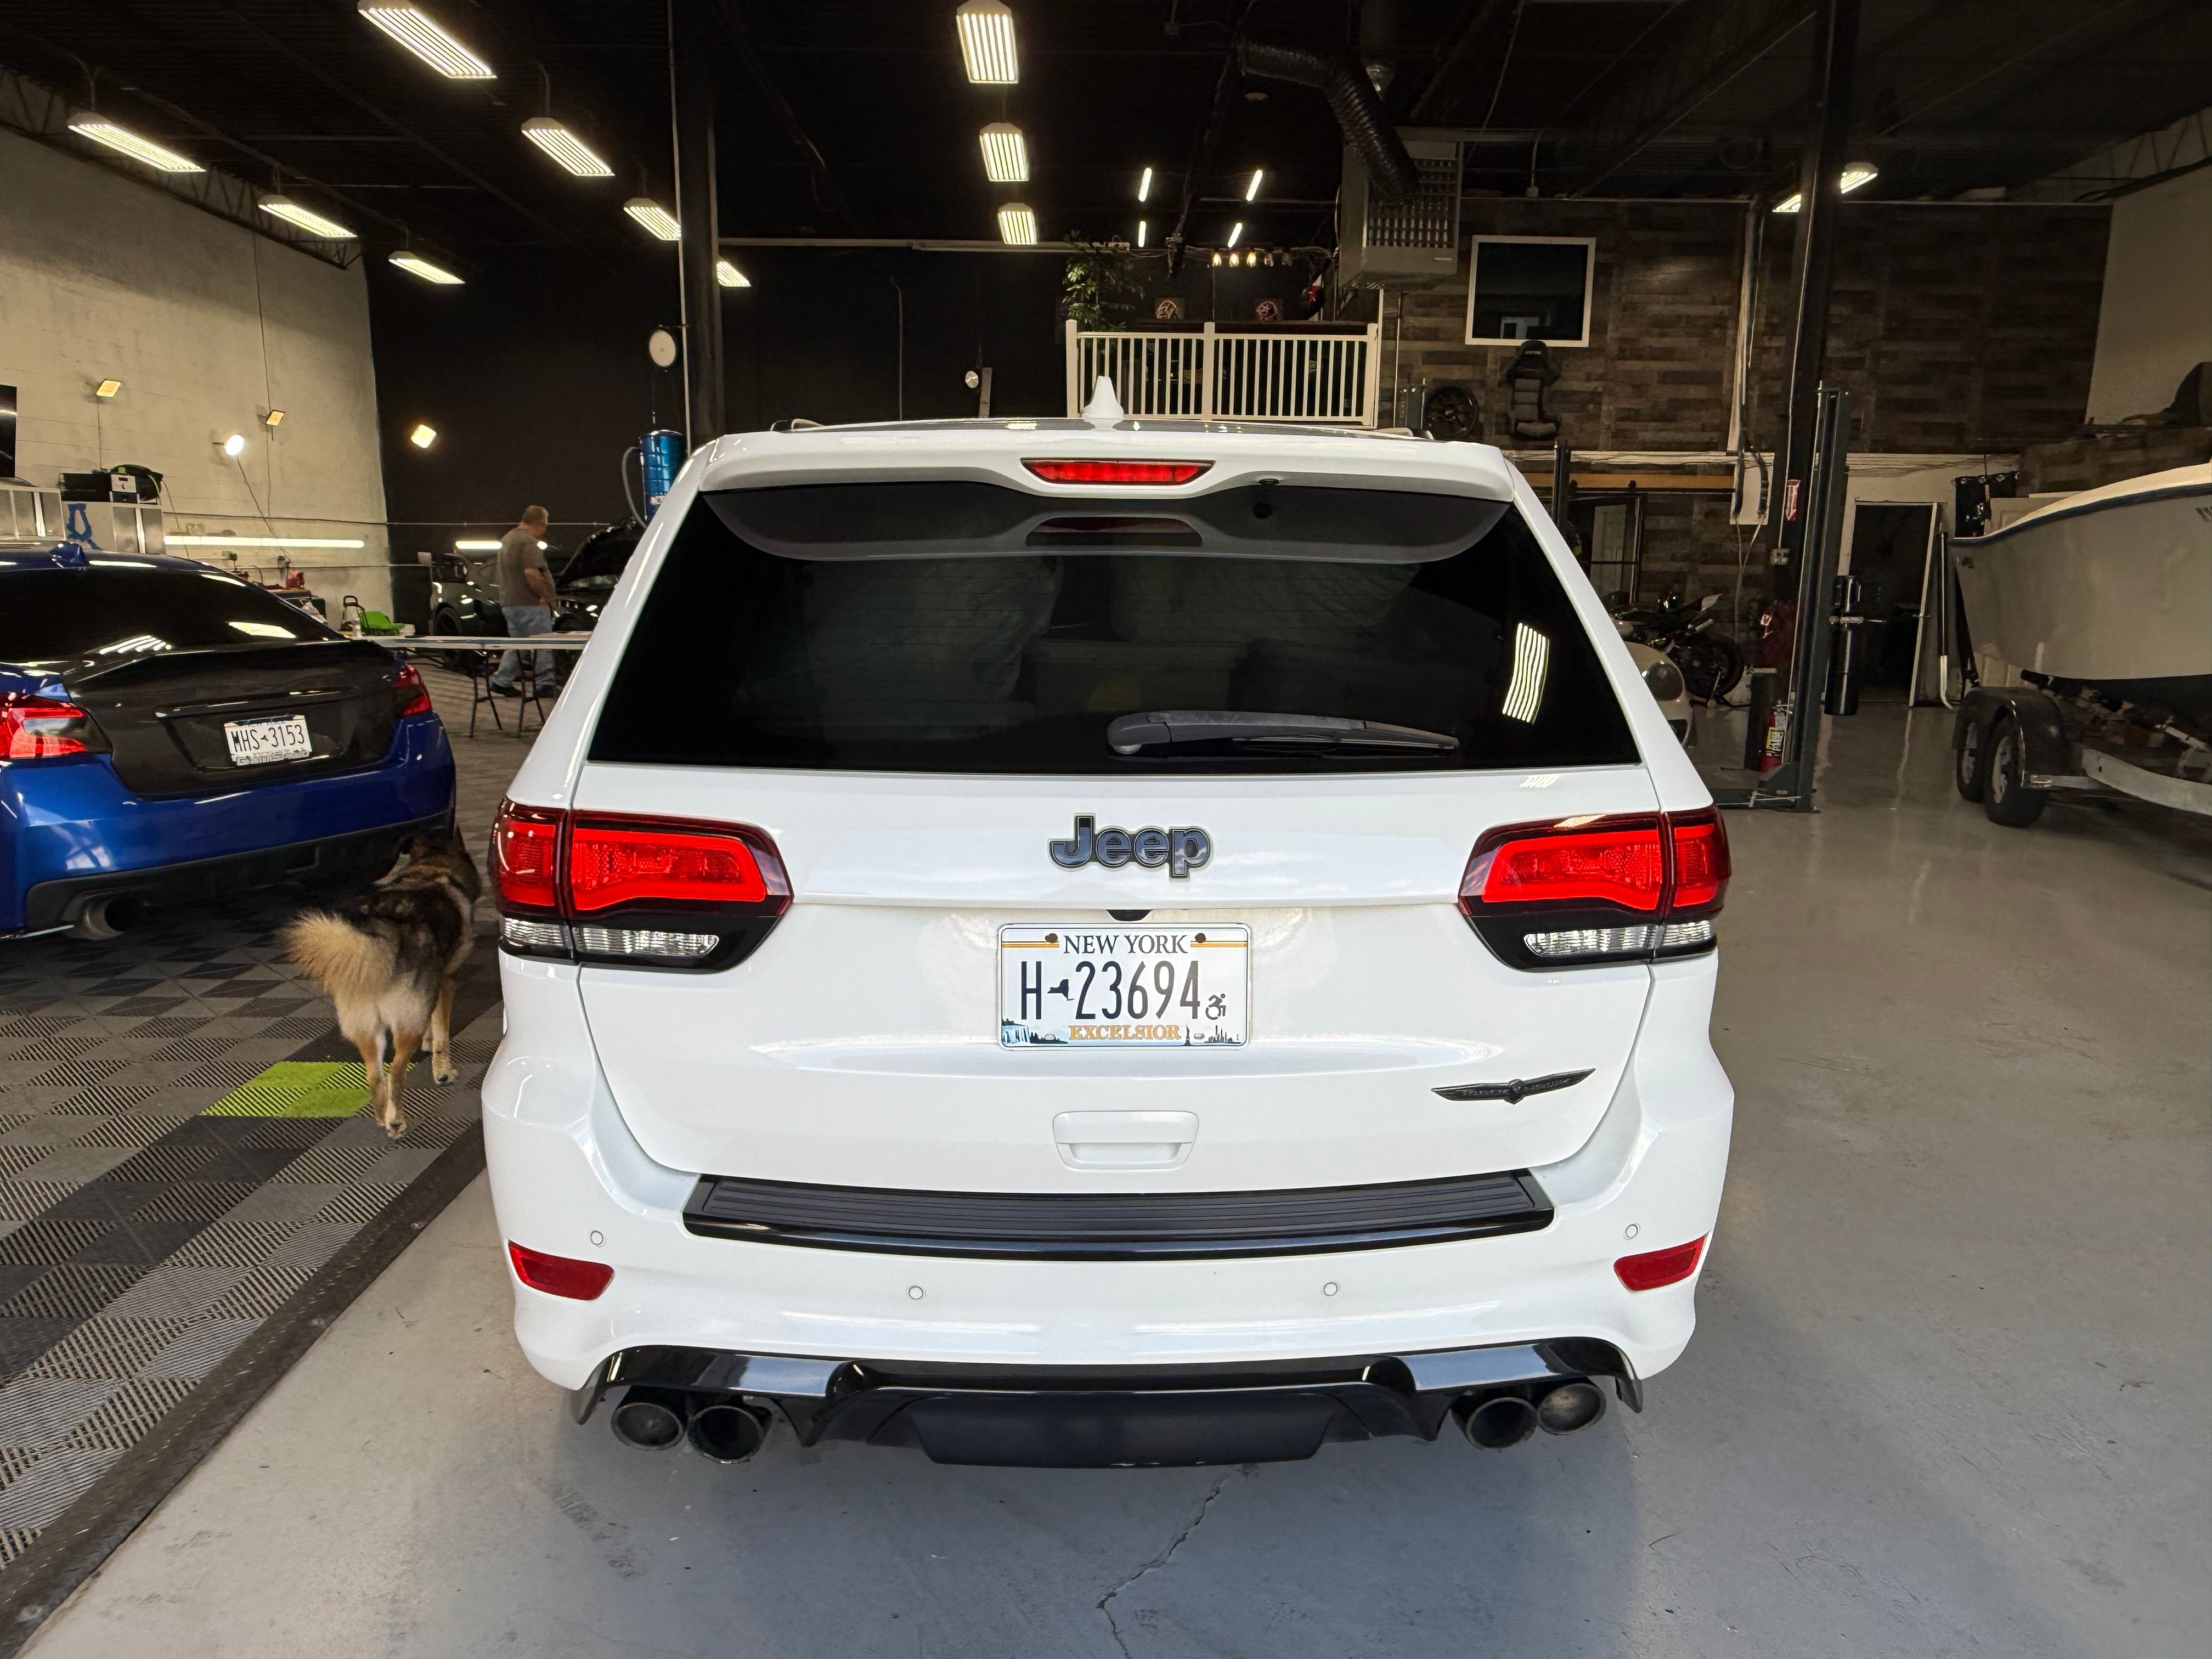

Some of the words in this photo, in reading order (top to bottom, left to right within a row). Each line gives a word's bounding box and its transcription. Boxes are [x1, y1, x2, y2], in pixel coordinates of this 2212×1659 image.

[268, 724, 305, 748] 3153
[1049, 814, 1211, 878] Jeep
[1063, 934, 1119, 954] NEW
[1124, 934, 1188, 954] YORK
[1069, 1024, 1181, 1040] EXCELSIOR
